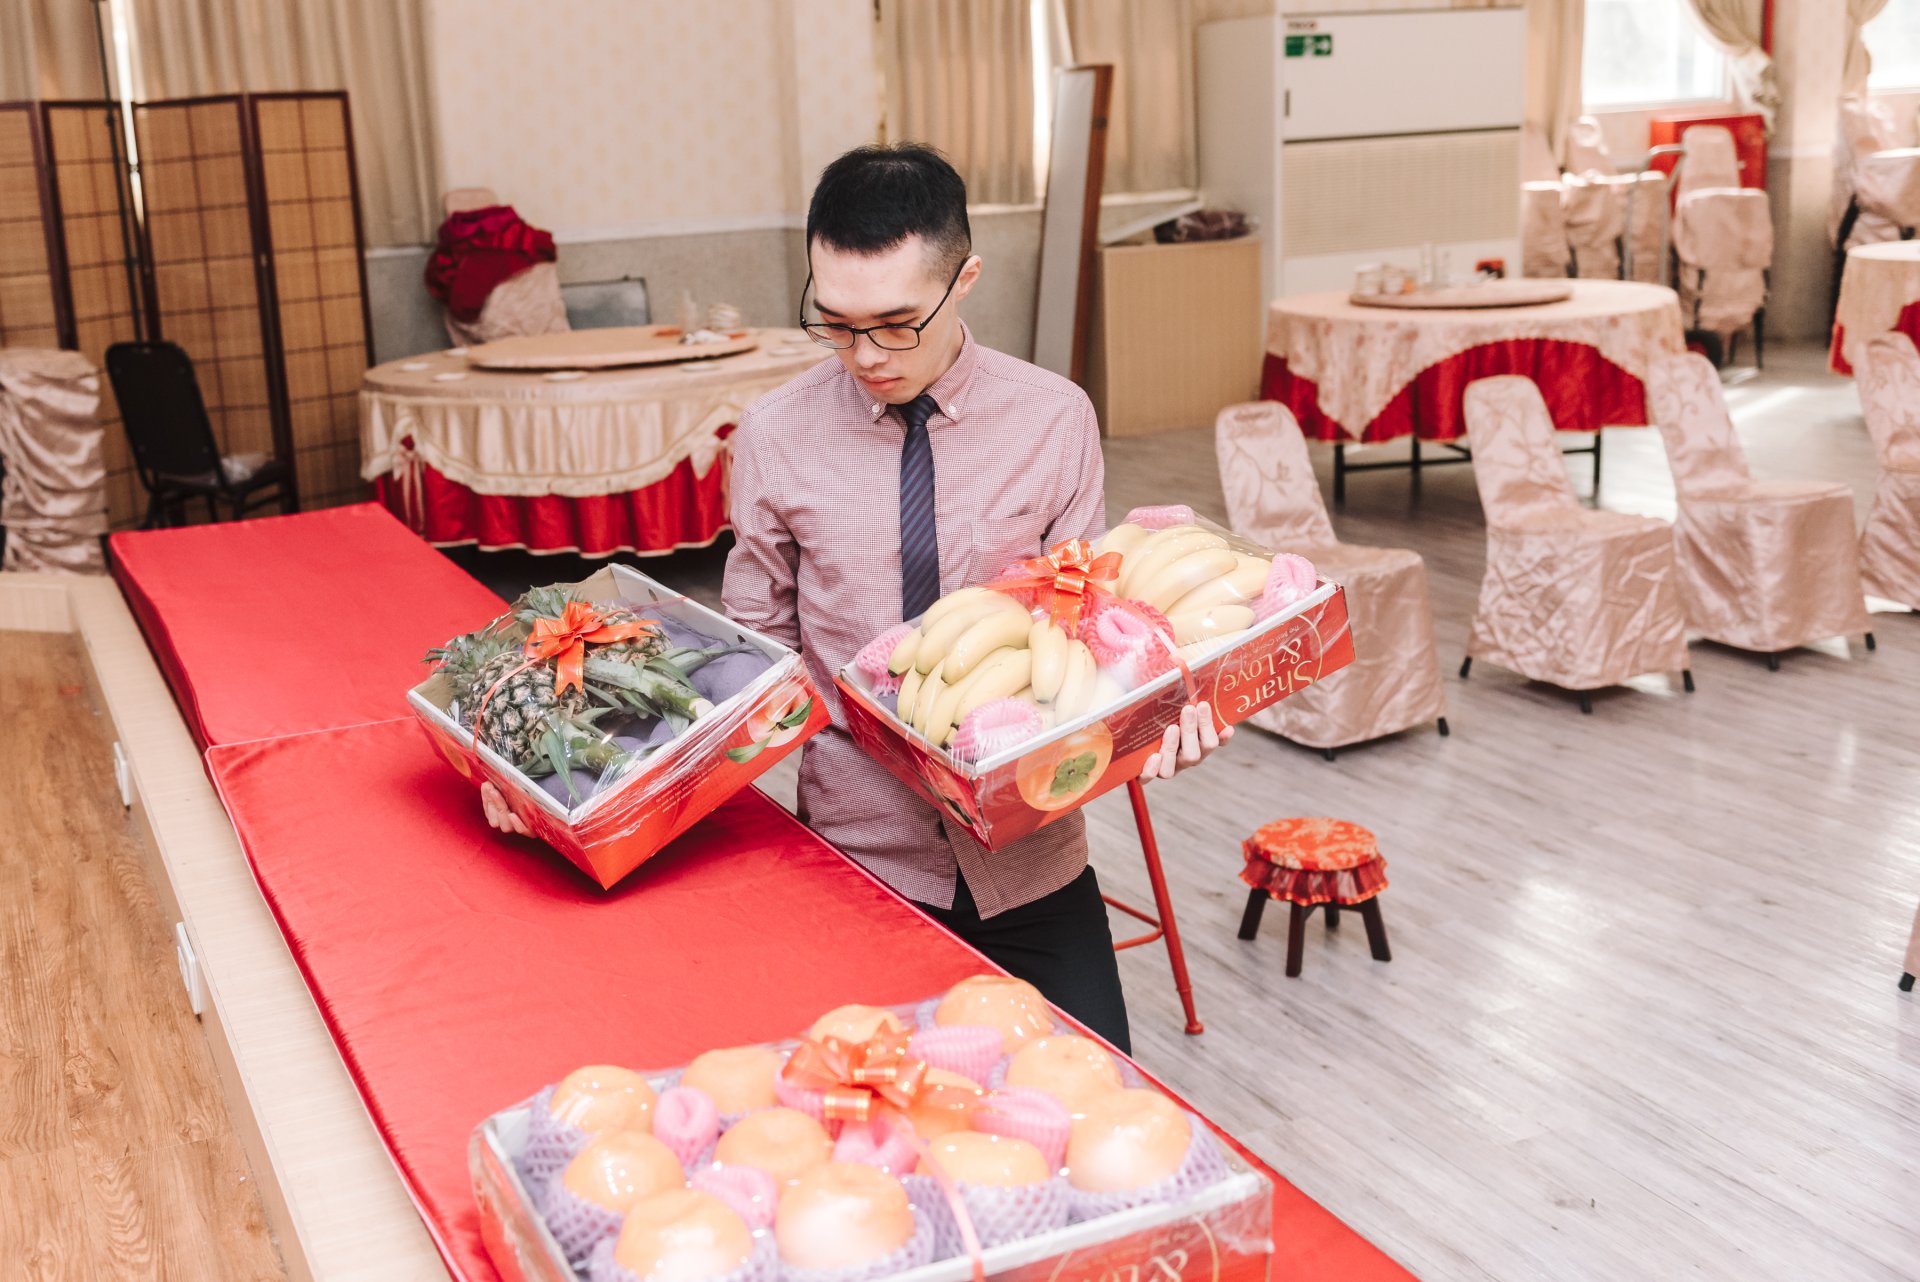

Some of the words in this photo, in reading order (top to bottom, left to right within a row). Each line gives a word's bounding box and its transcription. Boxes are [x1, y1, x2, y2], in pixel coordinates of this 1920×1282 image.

[1277, 637, 1302, 665] &
[1222, 653, 1276, 692] Love
[1236, 660, 1314, 713] Share
